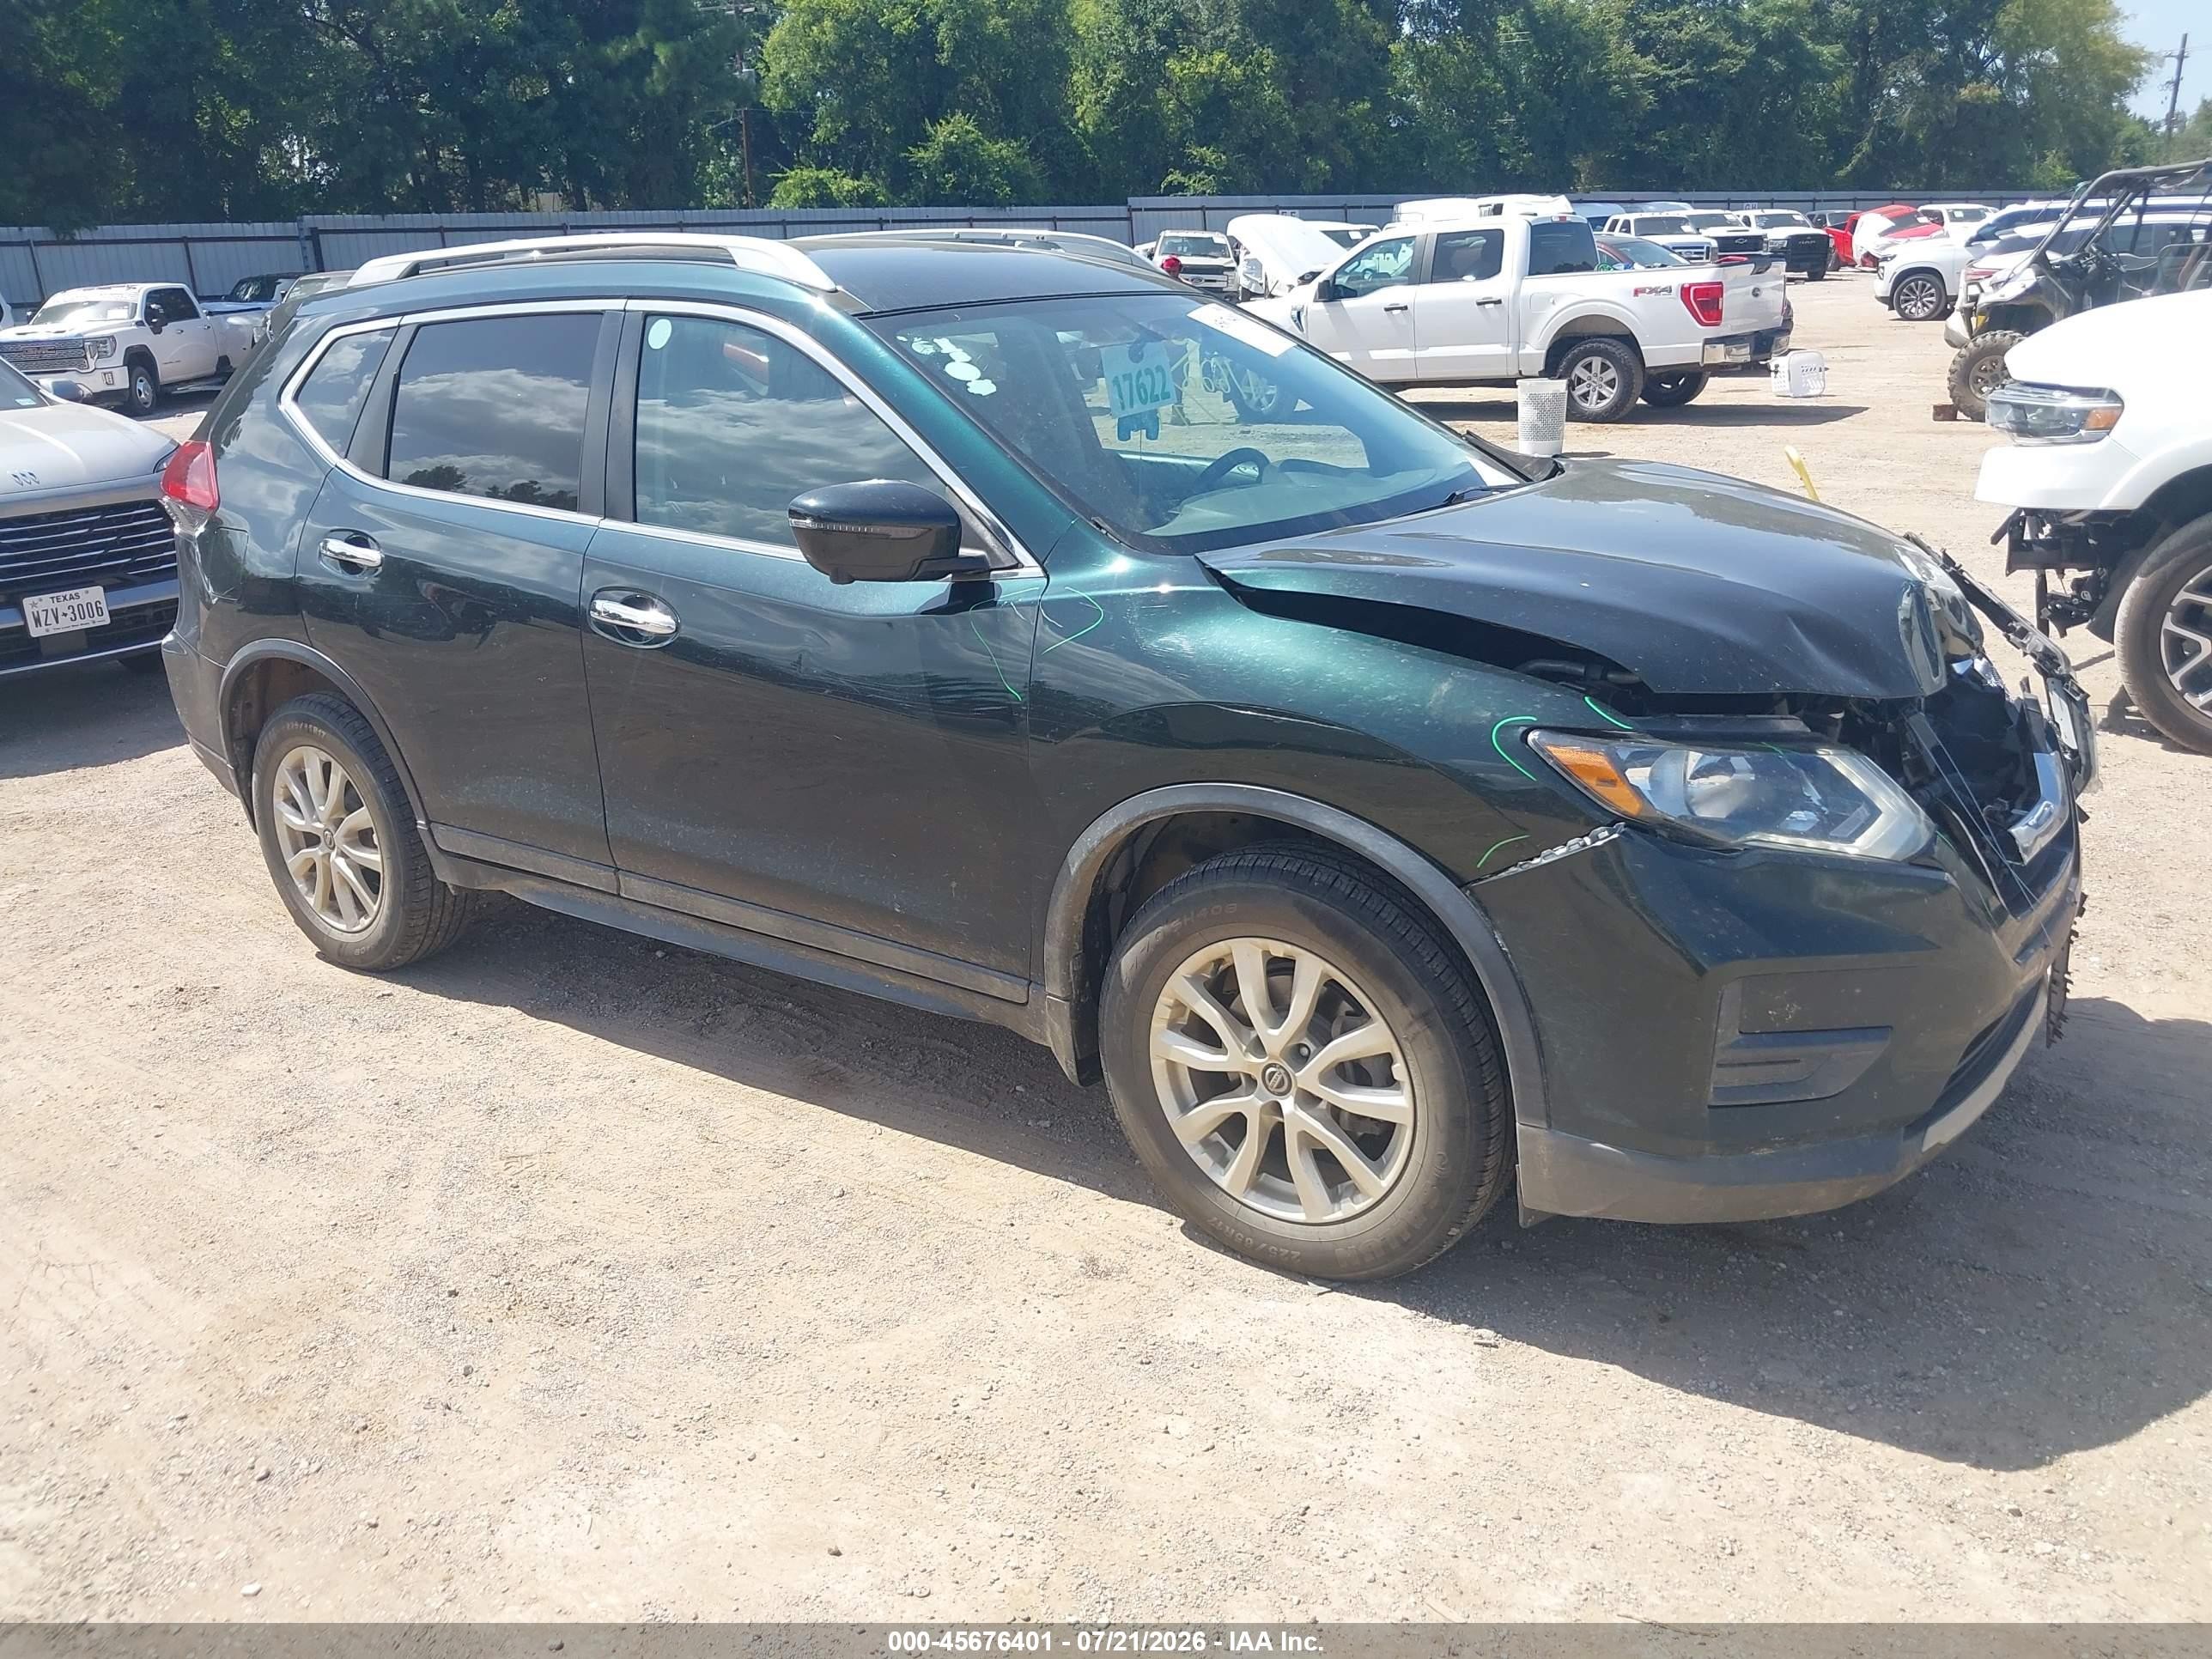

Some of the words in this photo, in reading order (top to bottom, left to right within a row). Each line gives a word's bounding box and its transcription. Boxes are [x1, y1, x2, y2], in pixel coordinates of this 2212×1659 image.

[1633, 285, 1672, 297] FX4
[1112, 365, 1170, 410] 17622
[50, 592, 81, 604] TEXAS
